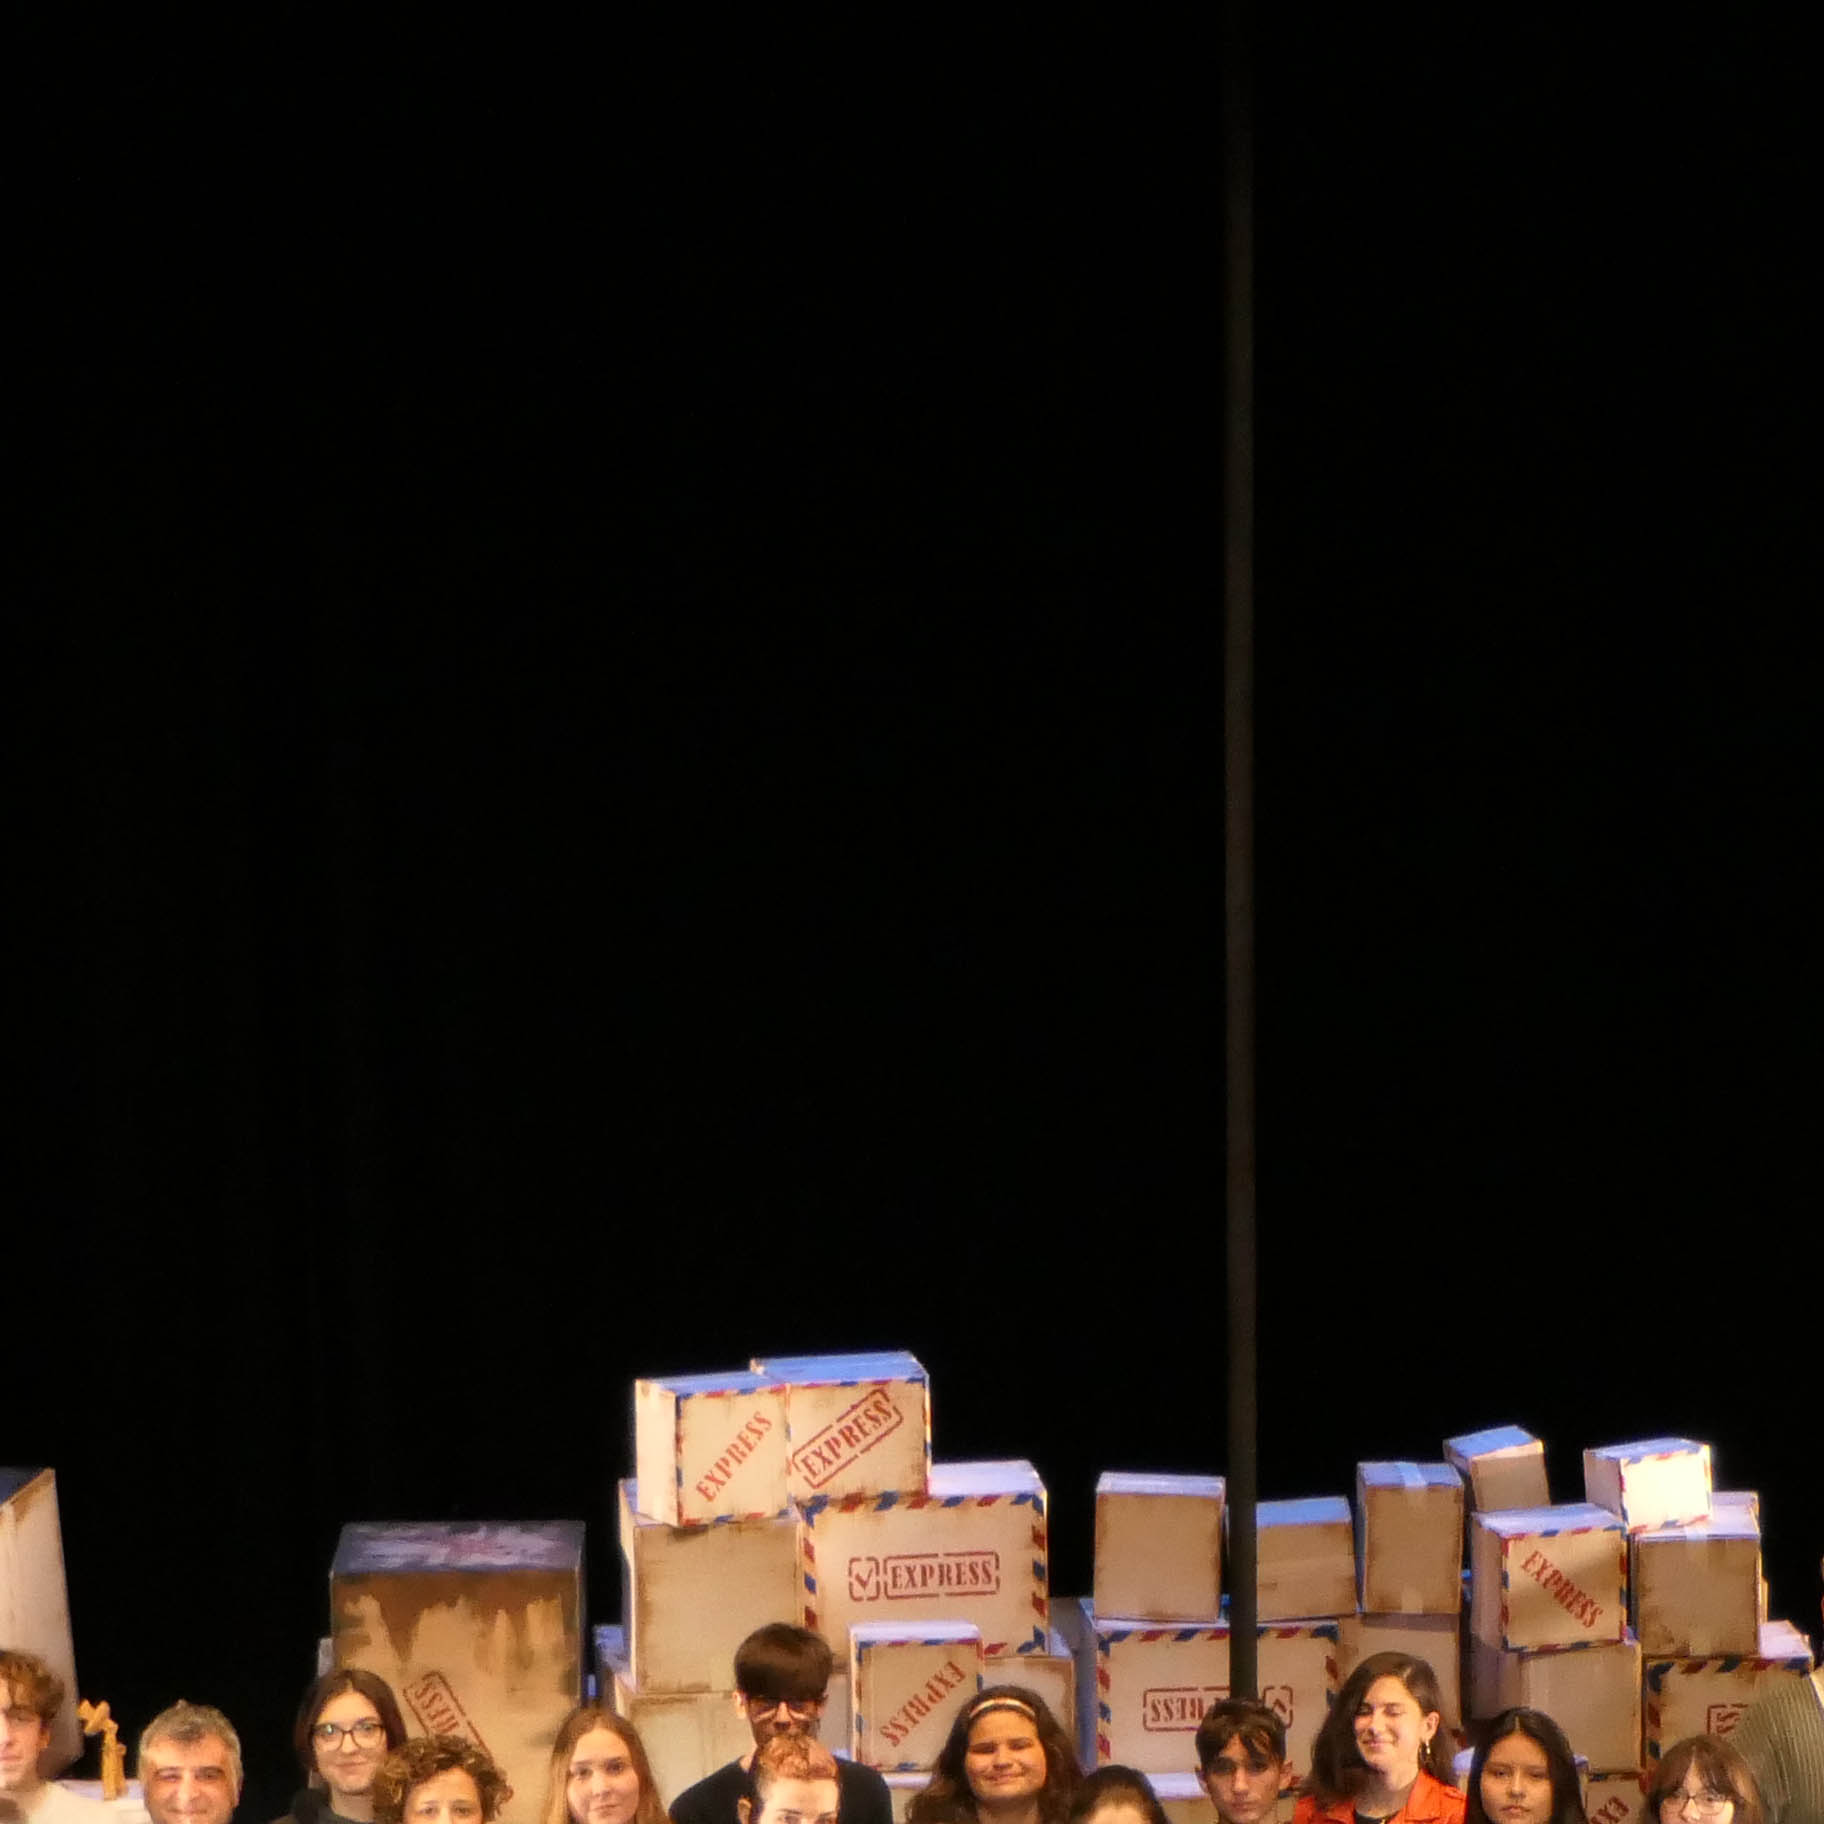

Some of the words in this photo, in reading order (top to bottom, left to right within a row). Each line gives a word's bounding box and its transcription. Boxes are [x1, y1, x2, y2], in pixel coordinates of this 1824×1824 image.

[695, 1411, 773, 1501] EXPRESS
[801, 1400, 893, 1477] EXPRESS
[891, 1560, 994, 1590] EXPRESS
[1520, 1550, 1604, 1628] EXPRESS
[879, 1661, 966, 1748] EXPRESS
